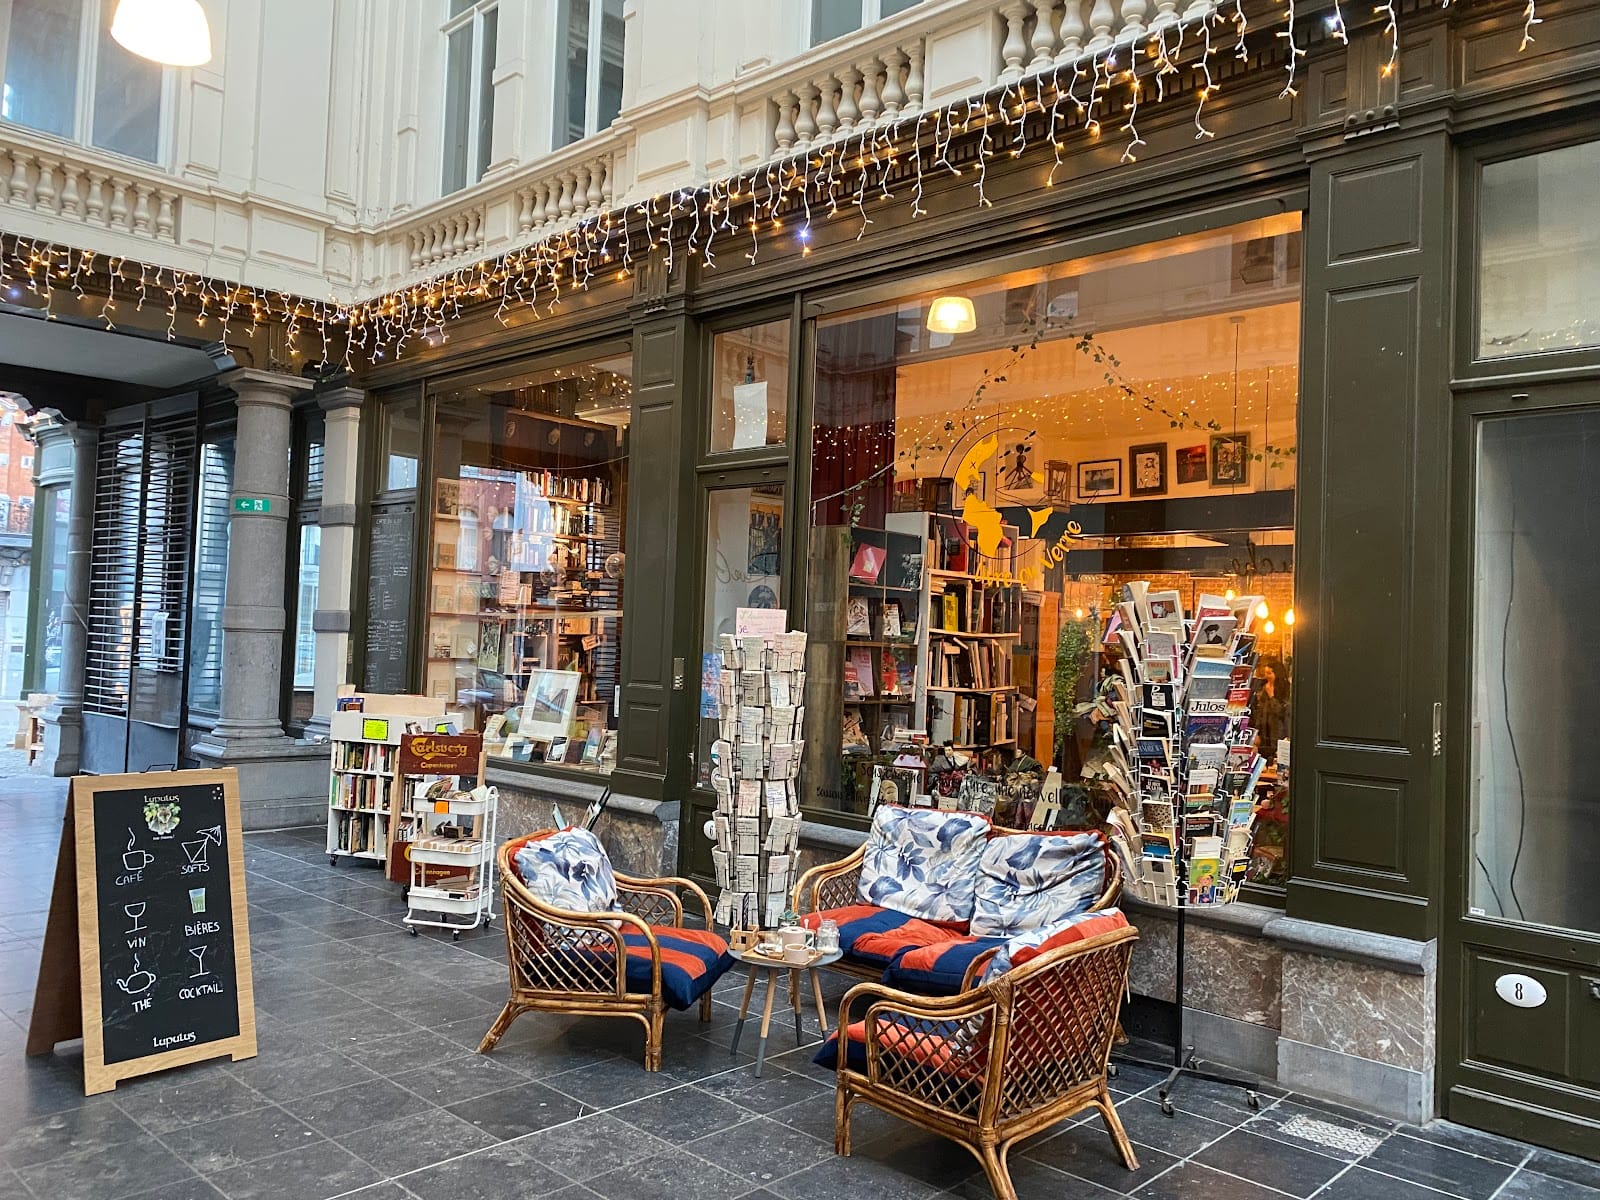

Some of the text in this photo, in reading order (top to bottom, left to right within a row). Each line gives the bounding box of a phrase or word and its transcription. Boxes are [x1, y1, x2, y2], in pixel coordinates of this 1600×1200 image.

[1039, 520, 1082, 570] Verre
[1191, 701, 1226, 712] Julos
[410, 737, 468, 758] Carlsberg
[143, 794, 180, 804] Lupulus
[180, 862, 210, 875] SOFTS
[184, 921, 220, 936] BIÈRES
[1514, 982, 1523, 1000] 8
[132, 992, 152, 1013] THÉ
[152, 1031, 197, 1049] Lupulus
